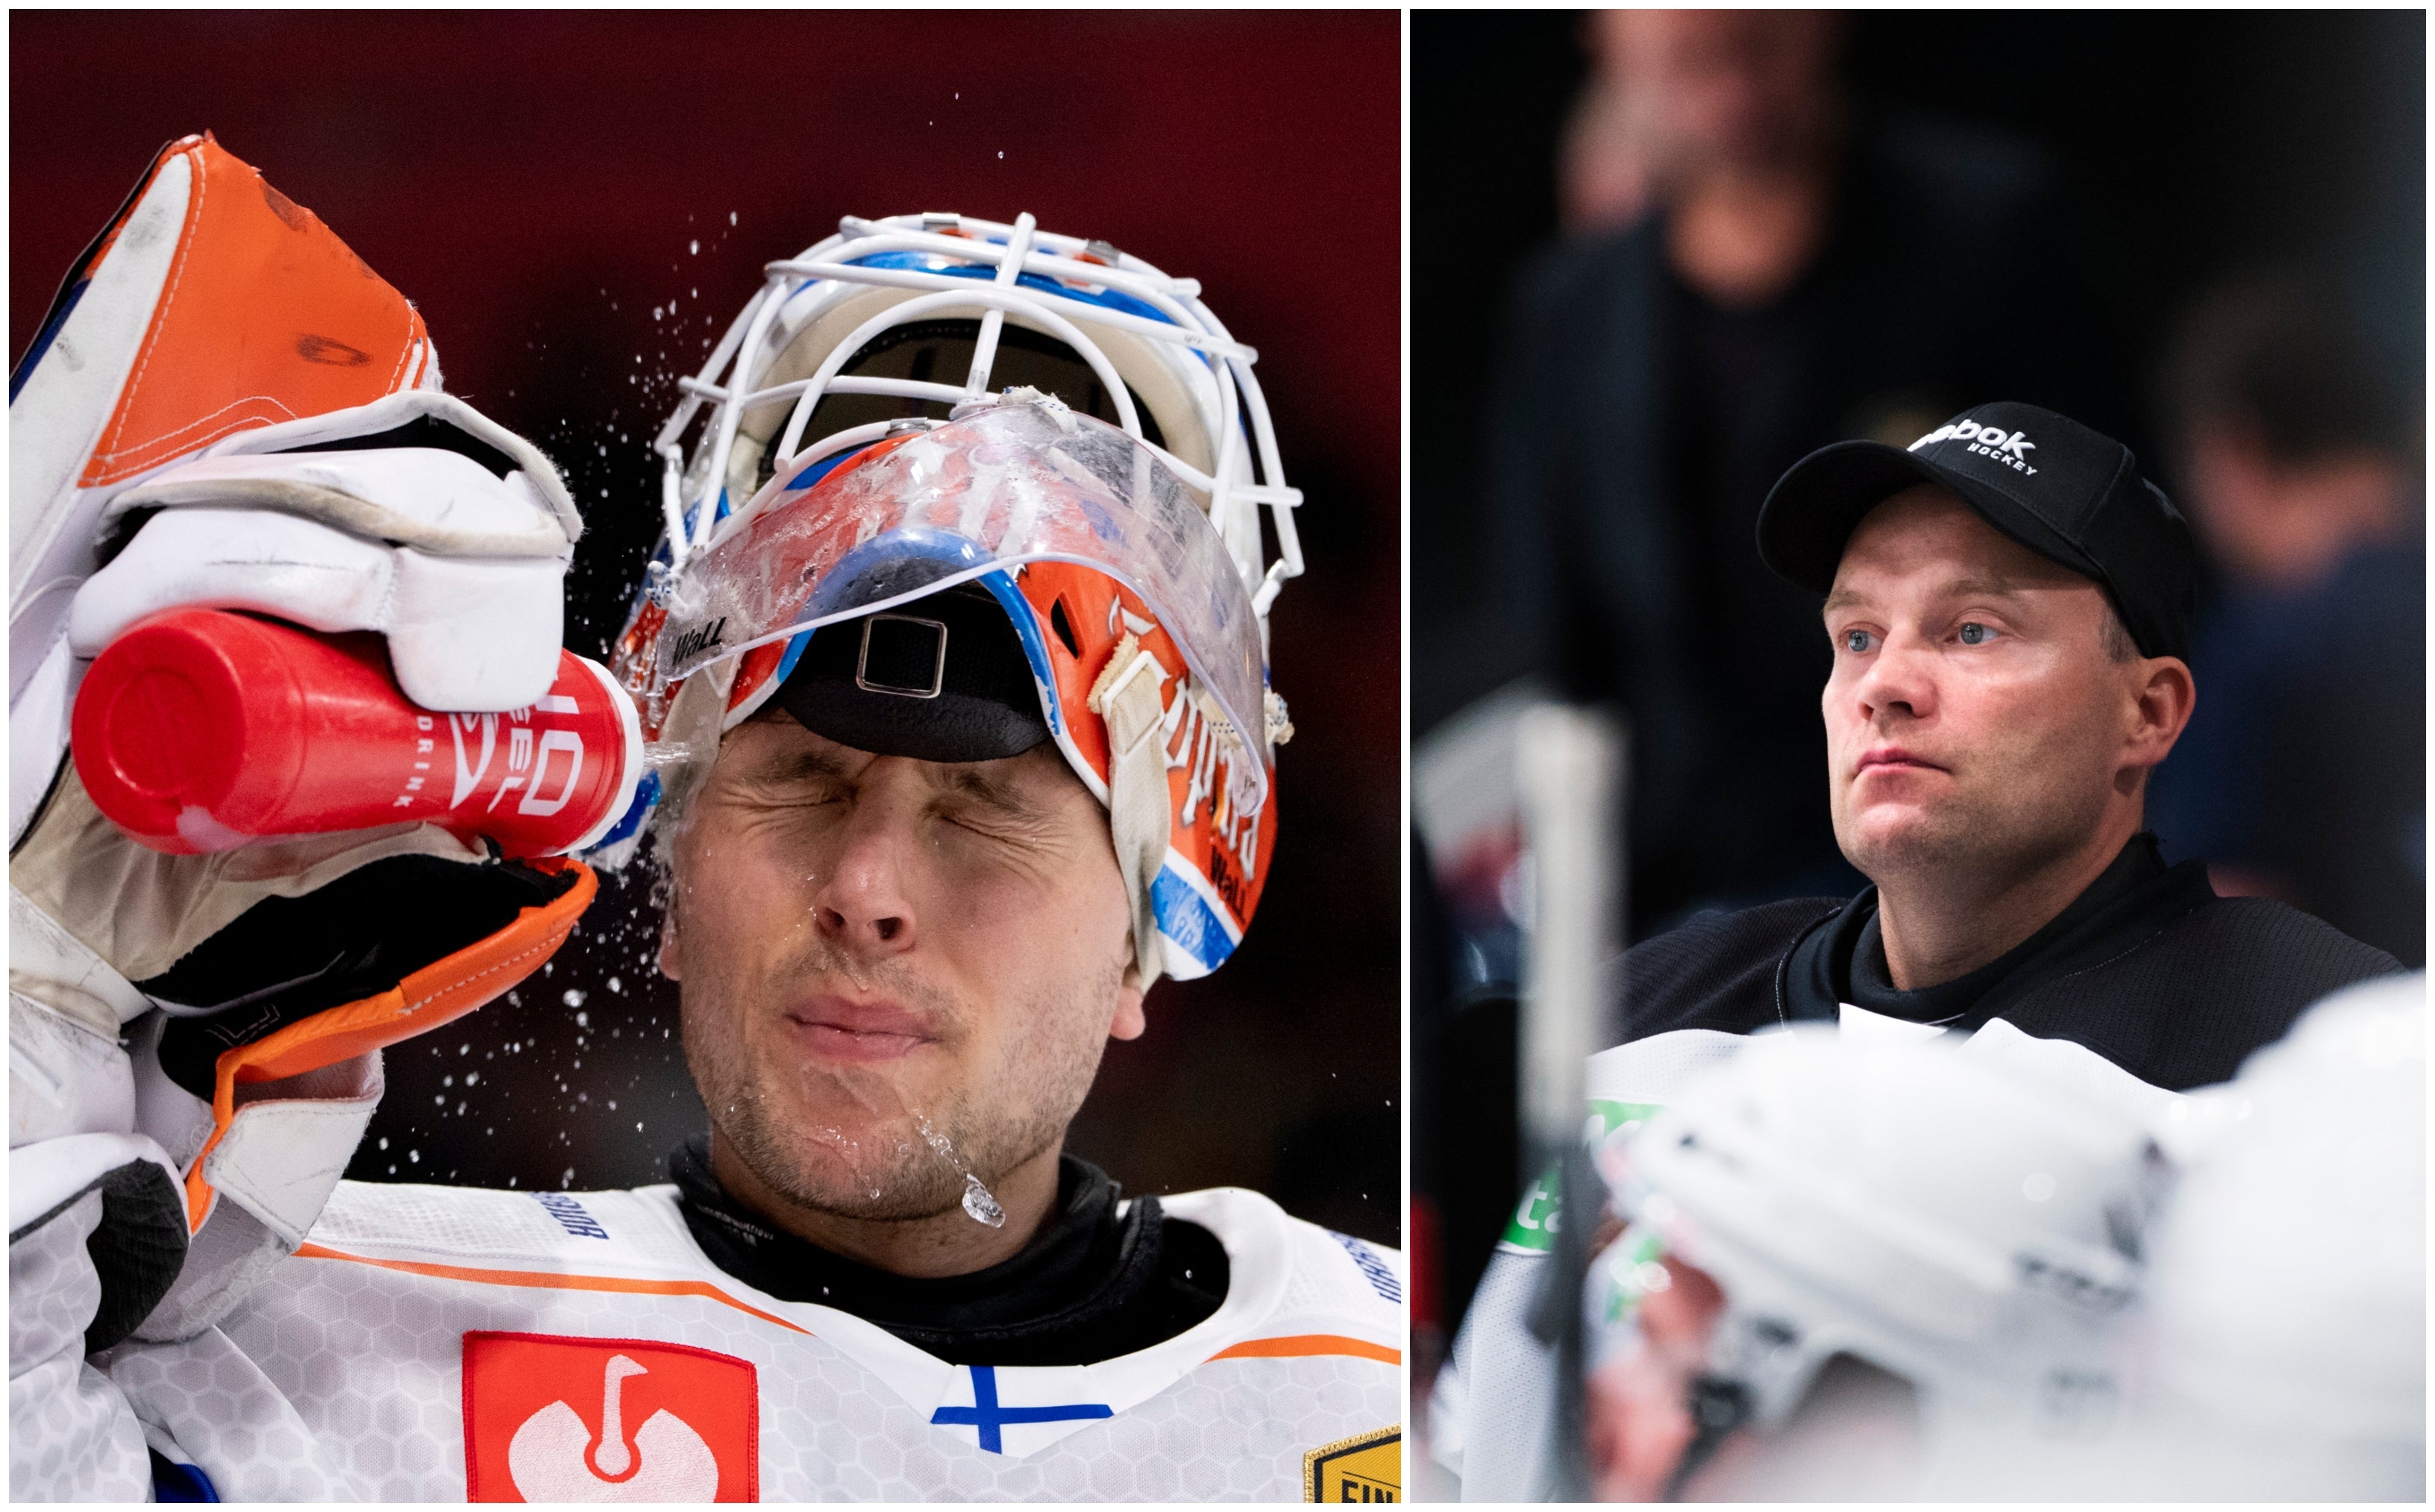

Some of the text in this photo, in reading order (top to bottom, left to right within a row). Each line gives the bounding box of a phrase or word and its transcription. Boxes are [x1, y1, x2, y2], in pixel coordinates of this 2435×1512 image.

[1967, 442, 2038, 476] HOCKEY
[392, 716, 433, 807] DRINK
[530, 1192, 609, 1240] RIOR
